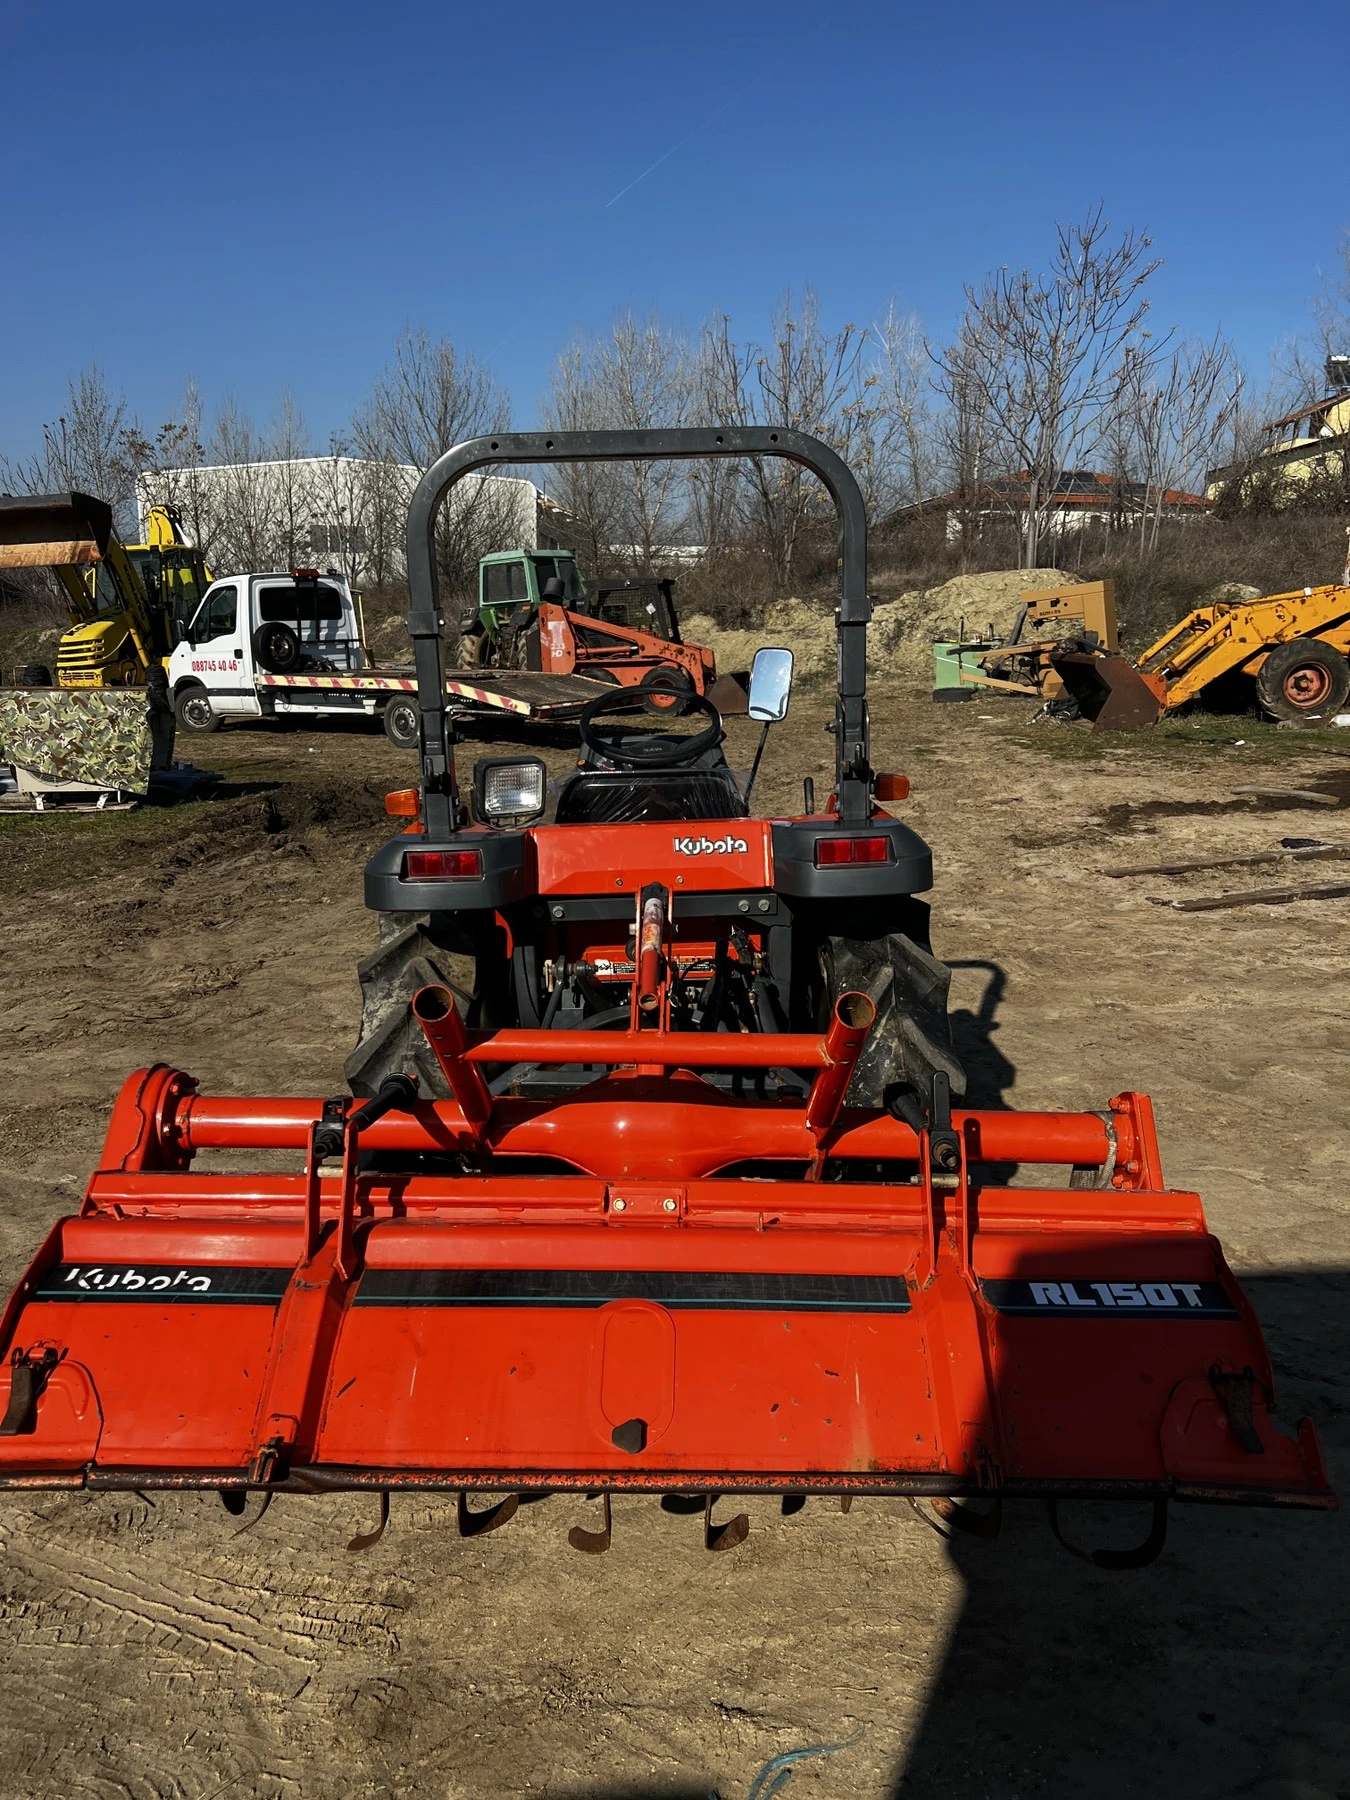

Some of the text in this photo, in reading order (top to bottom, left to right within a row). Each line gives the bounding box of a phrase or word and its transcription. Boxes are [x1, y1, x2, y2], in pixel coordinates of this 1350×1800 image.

[218, 660, 227, 671] 40
[228, 659, 238, 671] 46
[673, 834, 749, 856] Kubota
[64, 1268, 212, 1291] Kubota
[1028, 1282, 1203, 1307] RL150T
